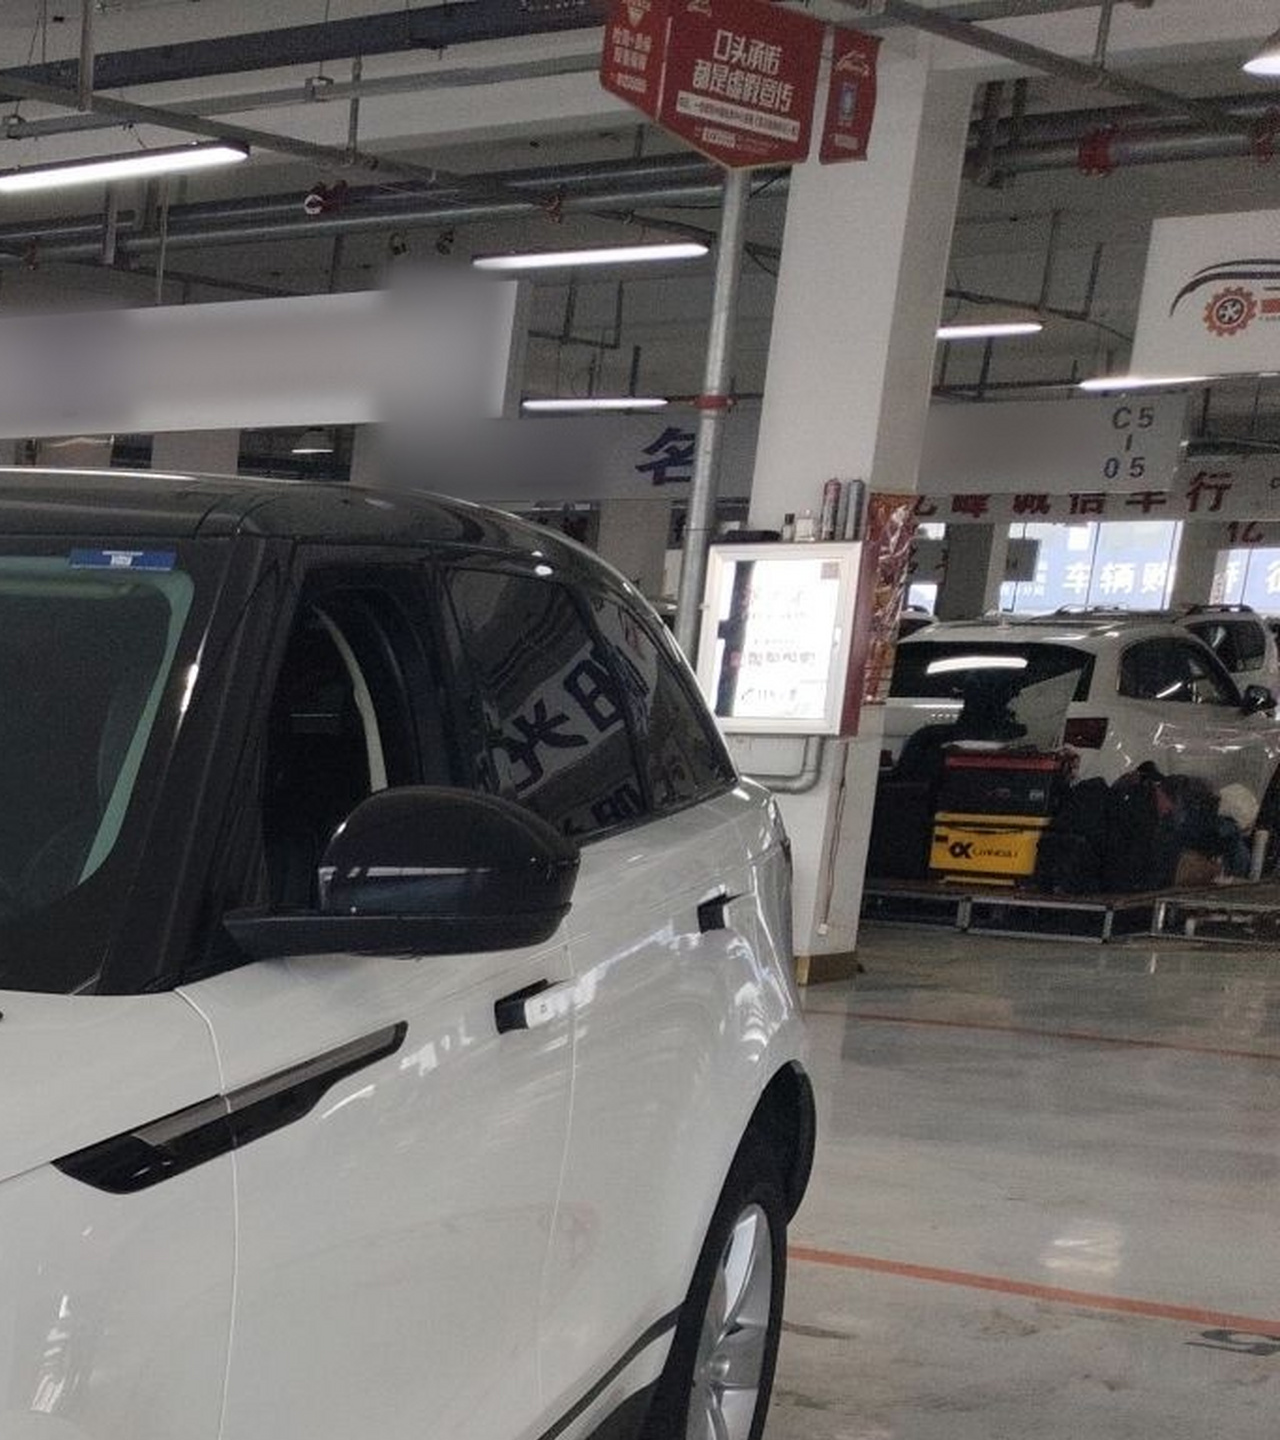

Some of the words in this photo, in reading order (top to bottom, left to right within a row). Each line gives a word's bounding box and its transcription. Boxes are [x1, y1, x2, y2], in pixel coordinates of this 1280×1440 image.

[713, 29, 783, 76] 口头承诺
[1112, 406, 1155, 430] C5
[1102, 457, 1146, 479] 05
